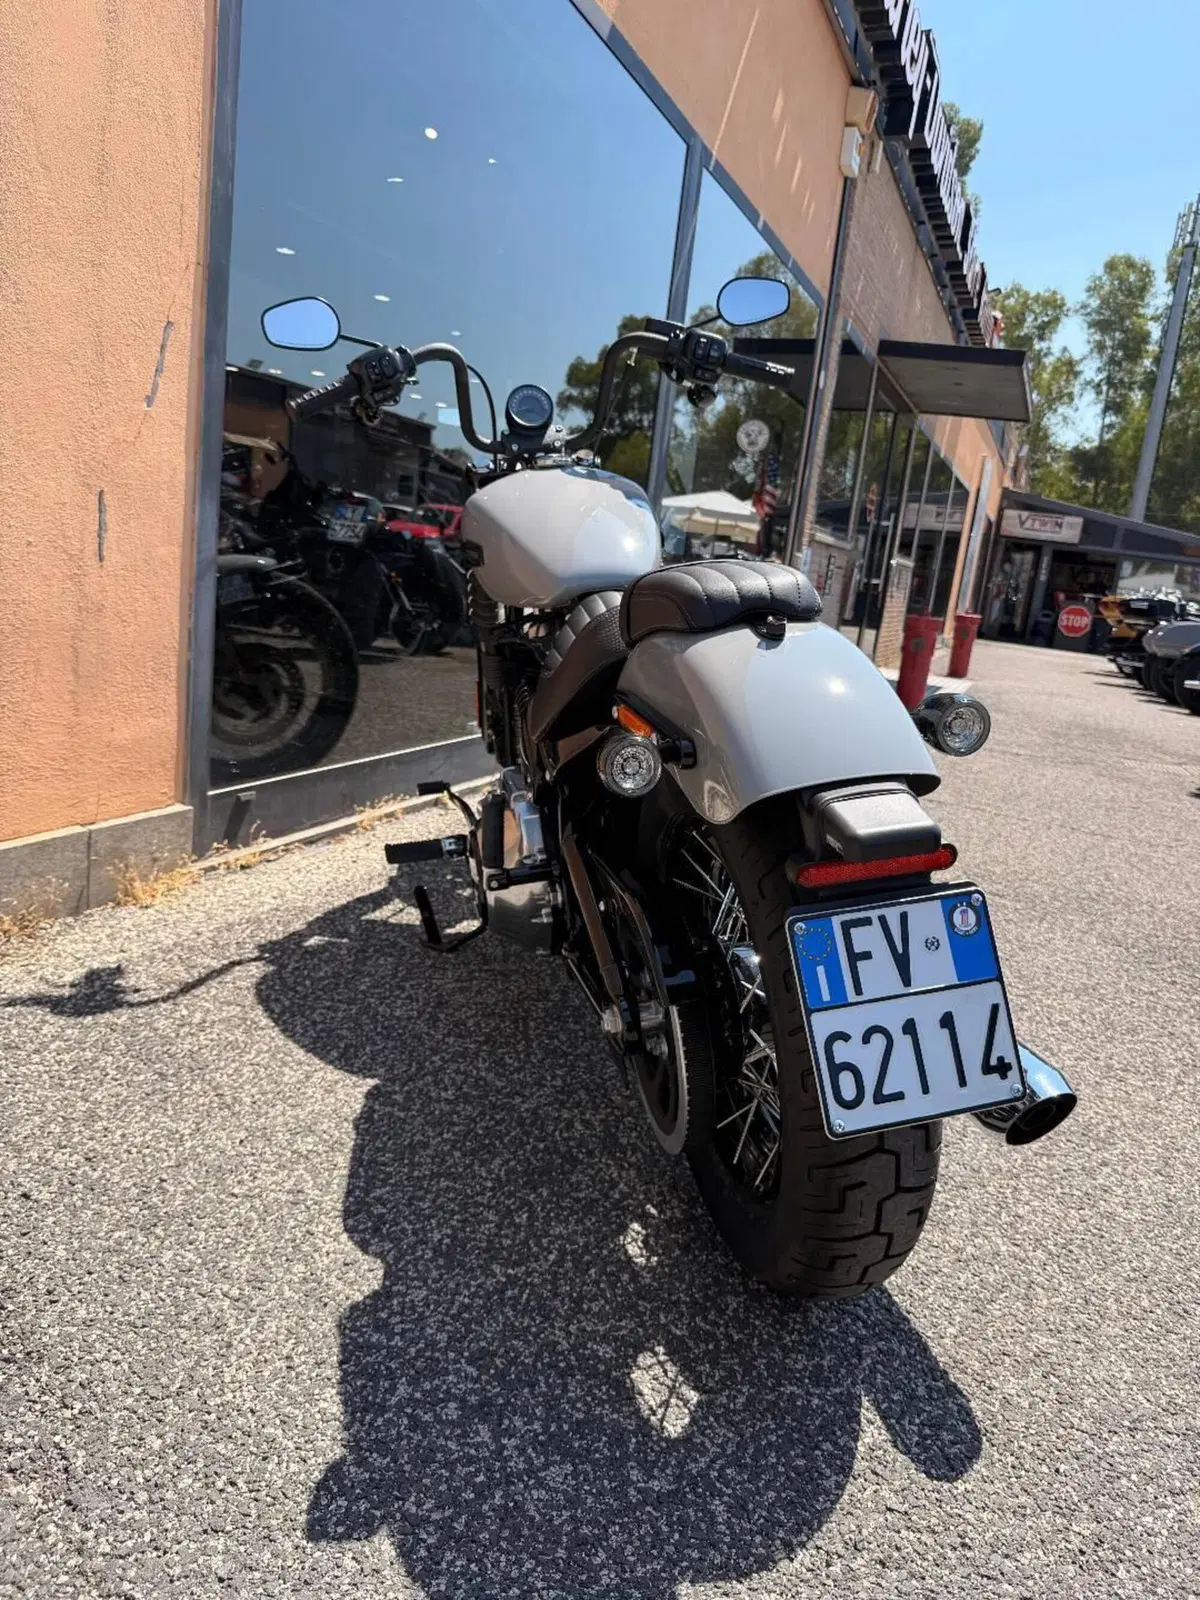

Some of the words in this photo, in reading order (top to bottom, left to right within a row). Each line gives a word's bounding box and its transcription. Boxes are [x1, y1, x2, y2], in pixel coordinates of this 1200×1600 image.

[1061, 614, 1089, 629] STOP
[841, 911, 912, 996] FV
[824, 1003, 1013, 1110] 62114
